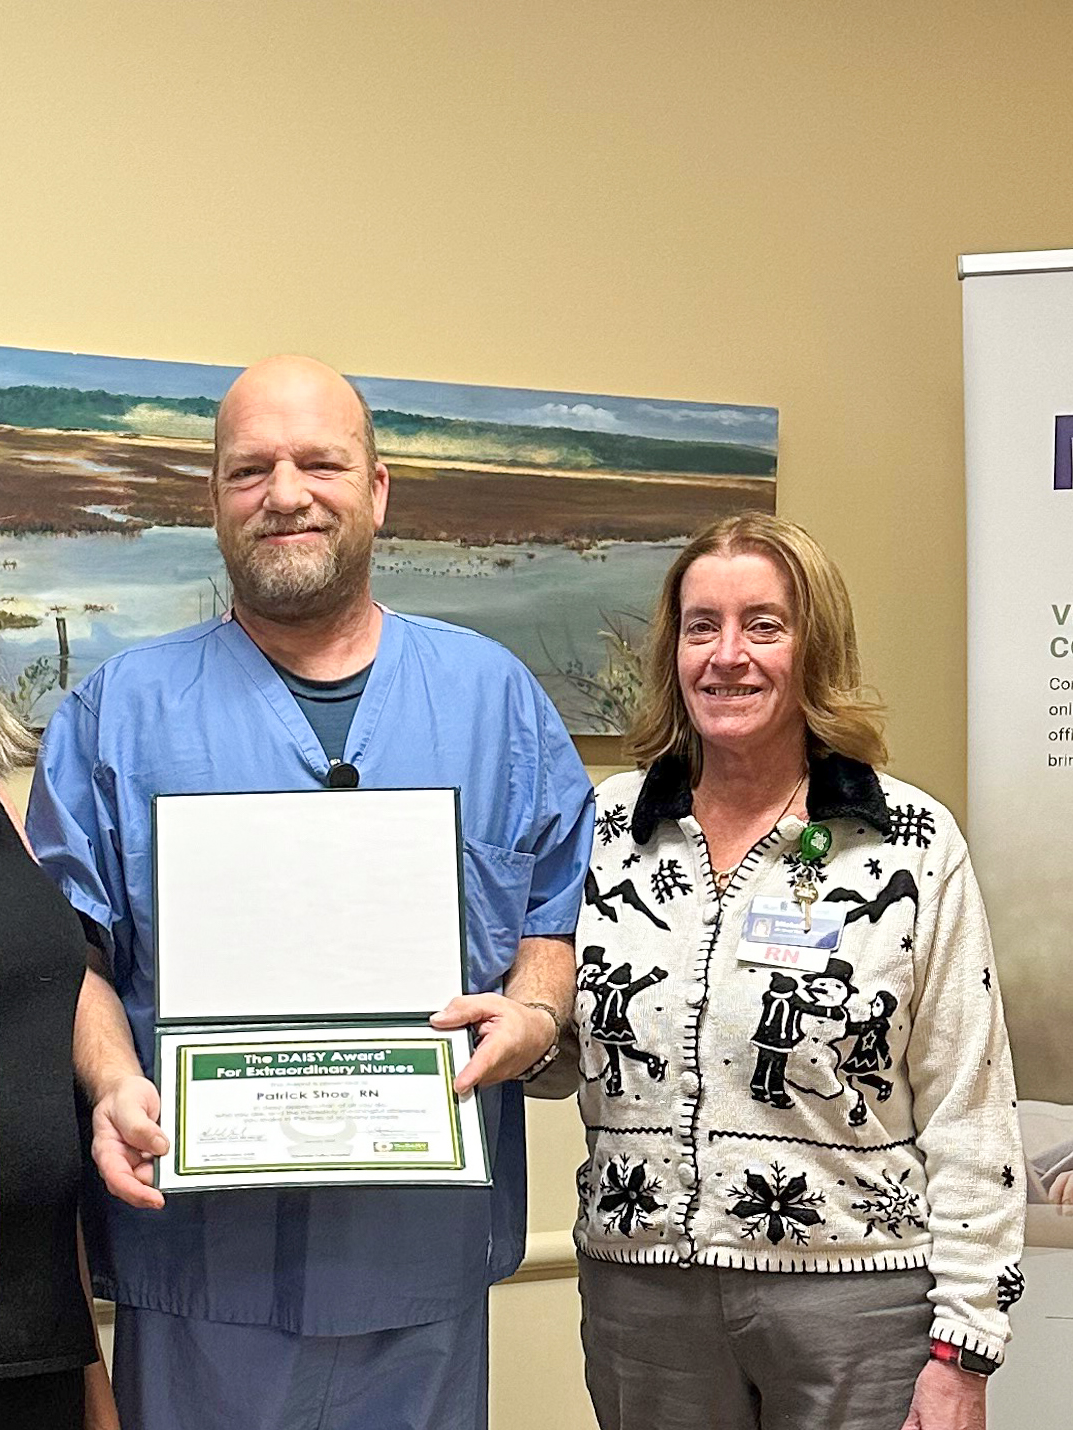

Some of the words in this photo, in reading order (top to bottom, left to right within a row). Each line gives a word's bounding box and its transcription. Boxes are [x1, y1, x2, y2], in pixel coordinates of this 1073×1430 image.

[1050, 636, 1073, 658] C
[764, 946, 800, 964] RN
[243, 1054, 273, 1065] The
[277, 1051, 328, 1064] DAISY
[216, 1067, 242, 1079] For
[245, 1063, 356, 1077] Extraordinary
[359, 1062, 415, 1074] Nurses
[256, 1091, 308, 1101] Patrick
[359, 1088, 380, 1098] RN
